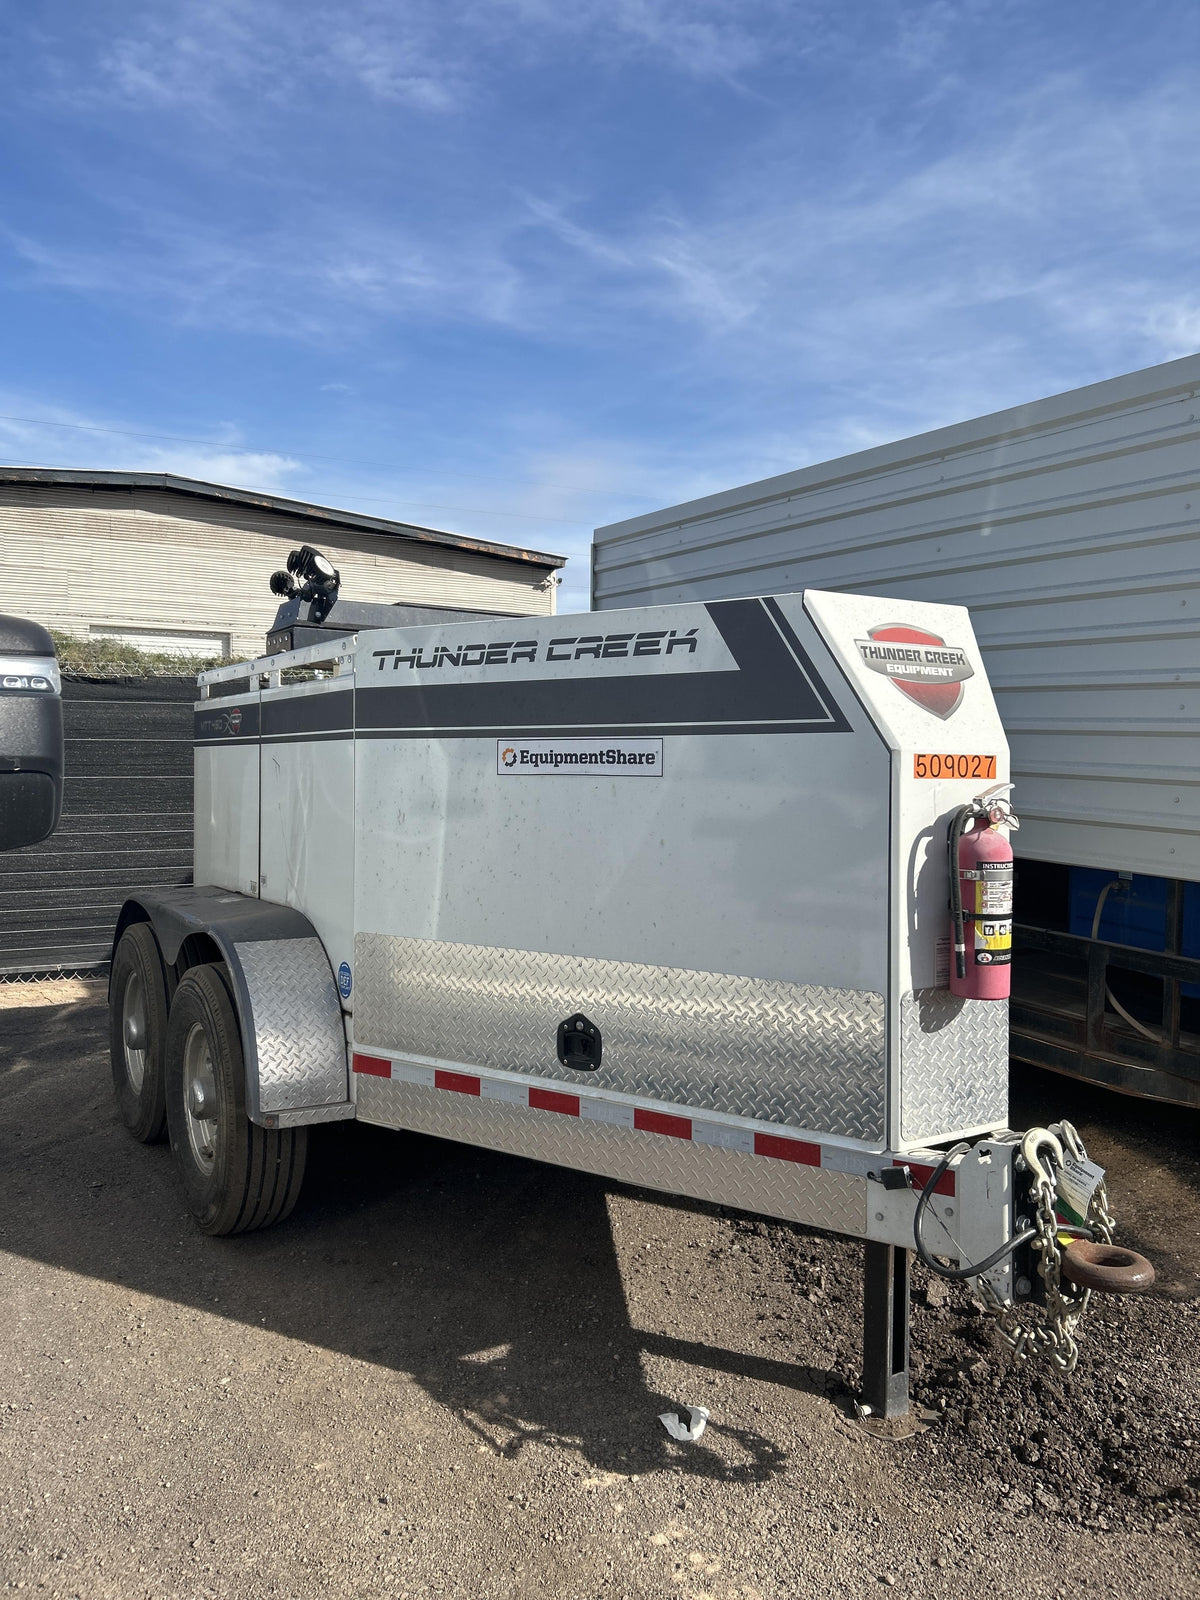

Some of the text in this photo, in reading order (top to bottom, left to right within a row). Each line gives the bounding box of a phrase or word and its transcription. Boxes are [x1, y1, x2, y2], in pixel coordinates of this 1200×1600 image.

[372, 628, 700, 671] THUNDER CREEK
[860, 645, 966, 666] THUNDER CREEK
[886, 663, 954, 677] EQUIPMENT
[519, 749, 656, 768] EquipmentShare
[916, 754, 994, 778] 509027
[340, 975, 350, 986] DEF
